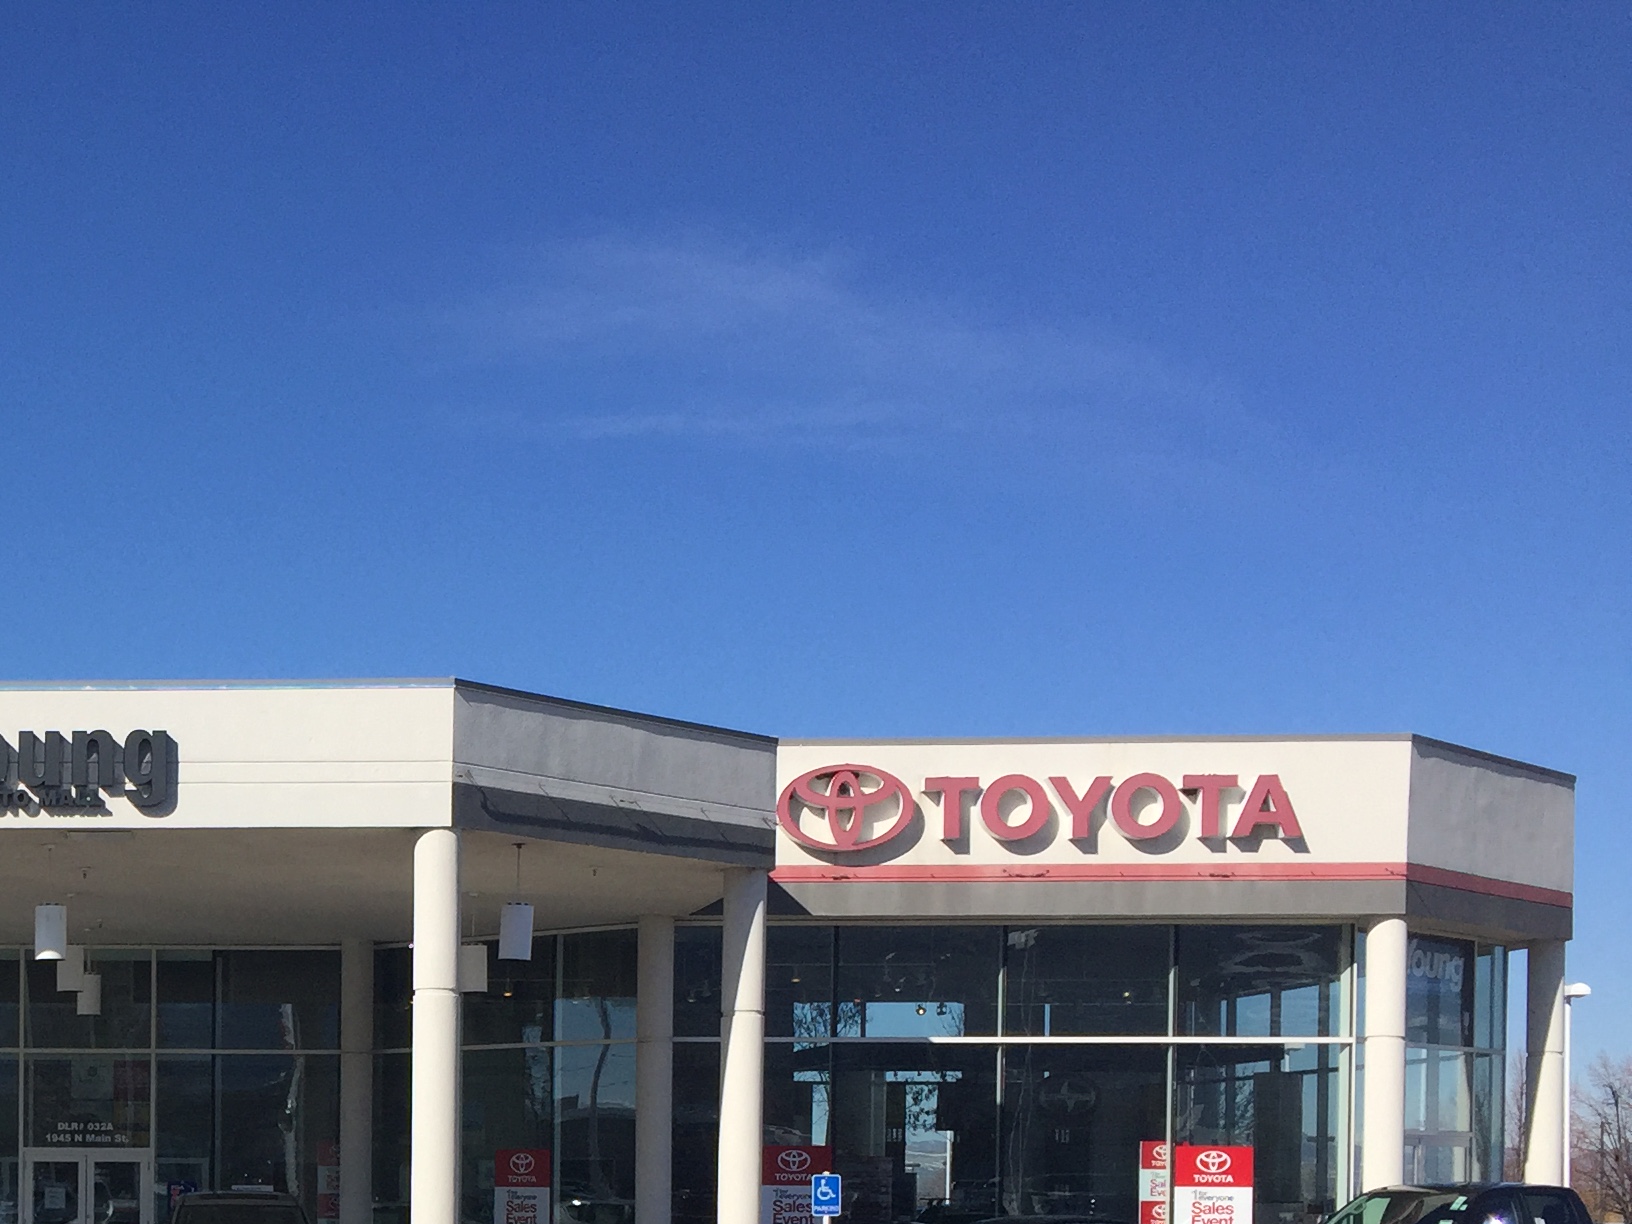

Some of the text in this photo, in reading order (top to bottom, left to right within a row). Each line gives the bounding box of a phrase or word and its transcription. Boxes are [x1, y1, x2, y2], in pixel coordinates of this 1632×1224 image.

[38, 789, 106, 808] MALL
[924, 773, 1304, 841] TOYOTA
[87, 1122, 113, 1131] 032A
[46, 1133, 72, 1142] 1945
[74, 1133, 83, 1142] N
[85, 1133, 111, 1142] Main
[508, 1175, 537, 1183] TOYOTA
[775, 1173, 813, 1181] TOYOTA
[1193, 1174, 1234, 1183] TOYOTA
[1198, 1195, 1235, 1203] everyone
[506, 1200, 537, 1213] Sales
[772, 1200, 813, 1213] Sales
[1191, 1201, 1235, 1214] Sales
